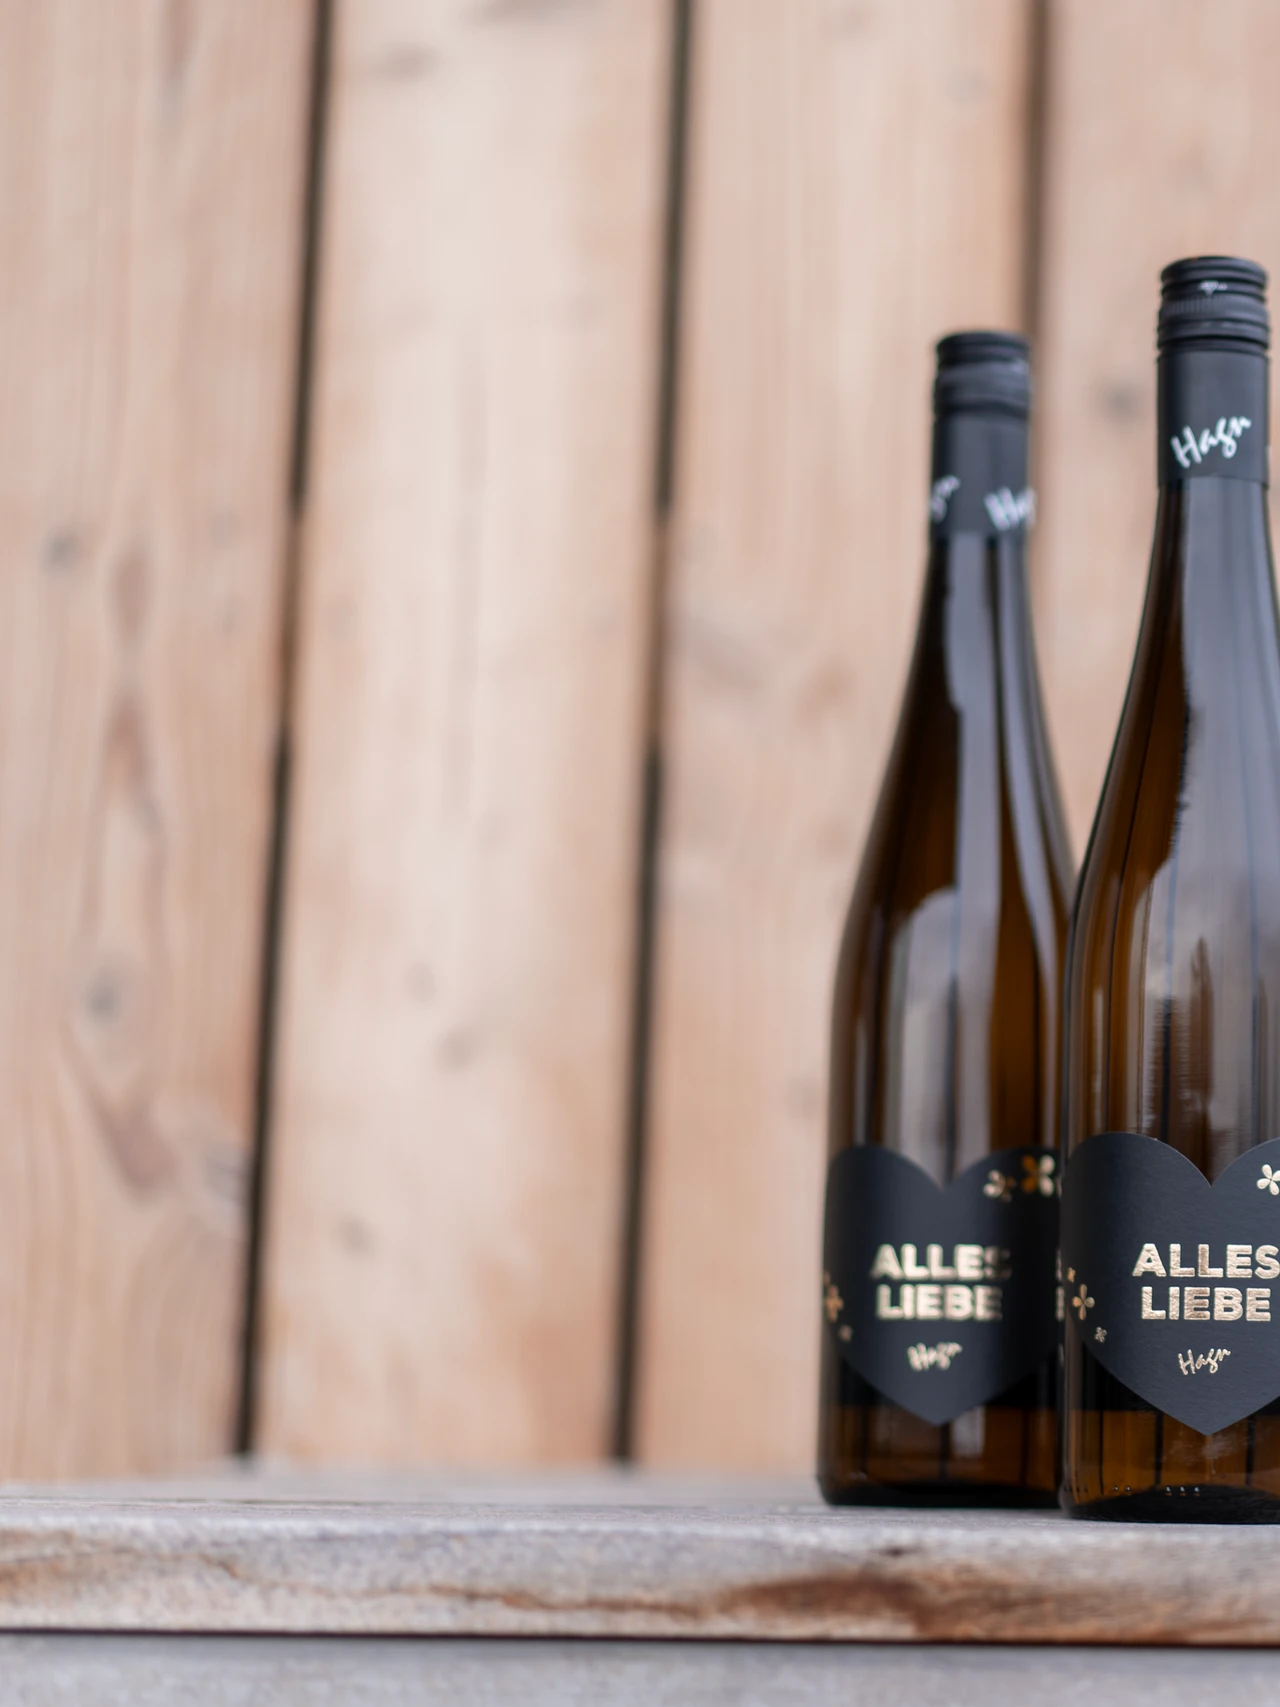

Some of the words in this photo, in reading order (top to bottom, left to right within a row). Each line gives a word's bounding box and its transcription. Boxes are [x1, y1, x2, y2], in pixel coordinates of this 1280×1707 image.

[1171, 416, 1252, 468] Hagn
[870, 1243, 1012, 1281] ALLES
[1132, 1243, 1280, 1279] ALLES
[875, 1284, 1003, 1321] LIEBE
[1141, 1286, 1272, 1322] LIEBE
[1177, 1348, 1232, 1375] Hagn
